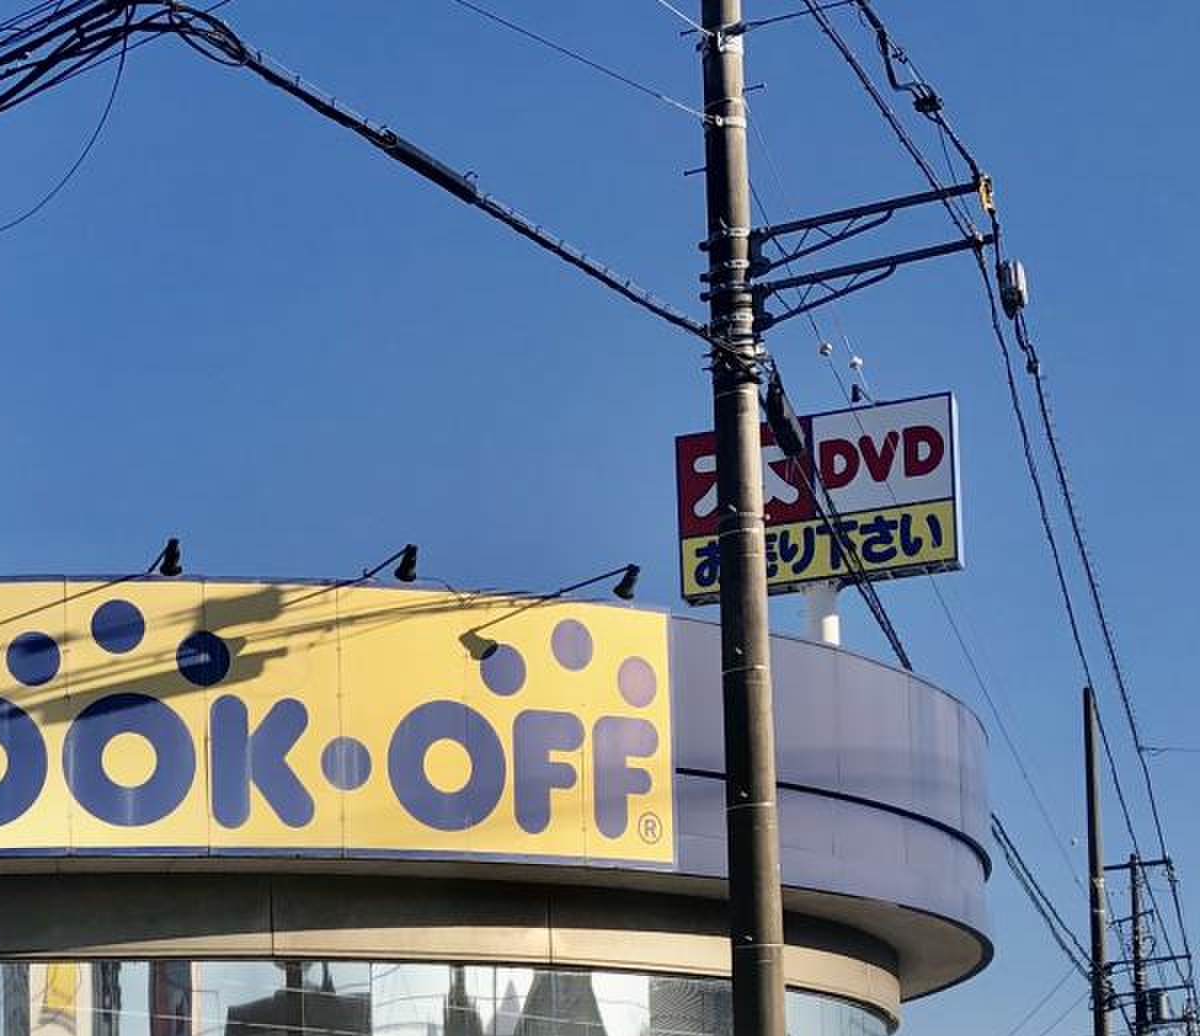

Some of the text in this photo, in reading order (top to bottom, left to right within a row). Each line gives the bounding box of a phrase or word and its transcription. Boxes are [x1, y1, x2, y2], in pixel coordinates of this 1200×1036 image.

[818, 425, 945, 491] DVD
[693, 512, 943, 588] おり下さい
